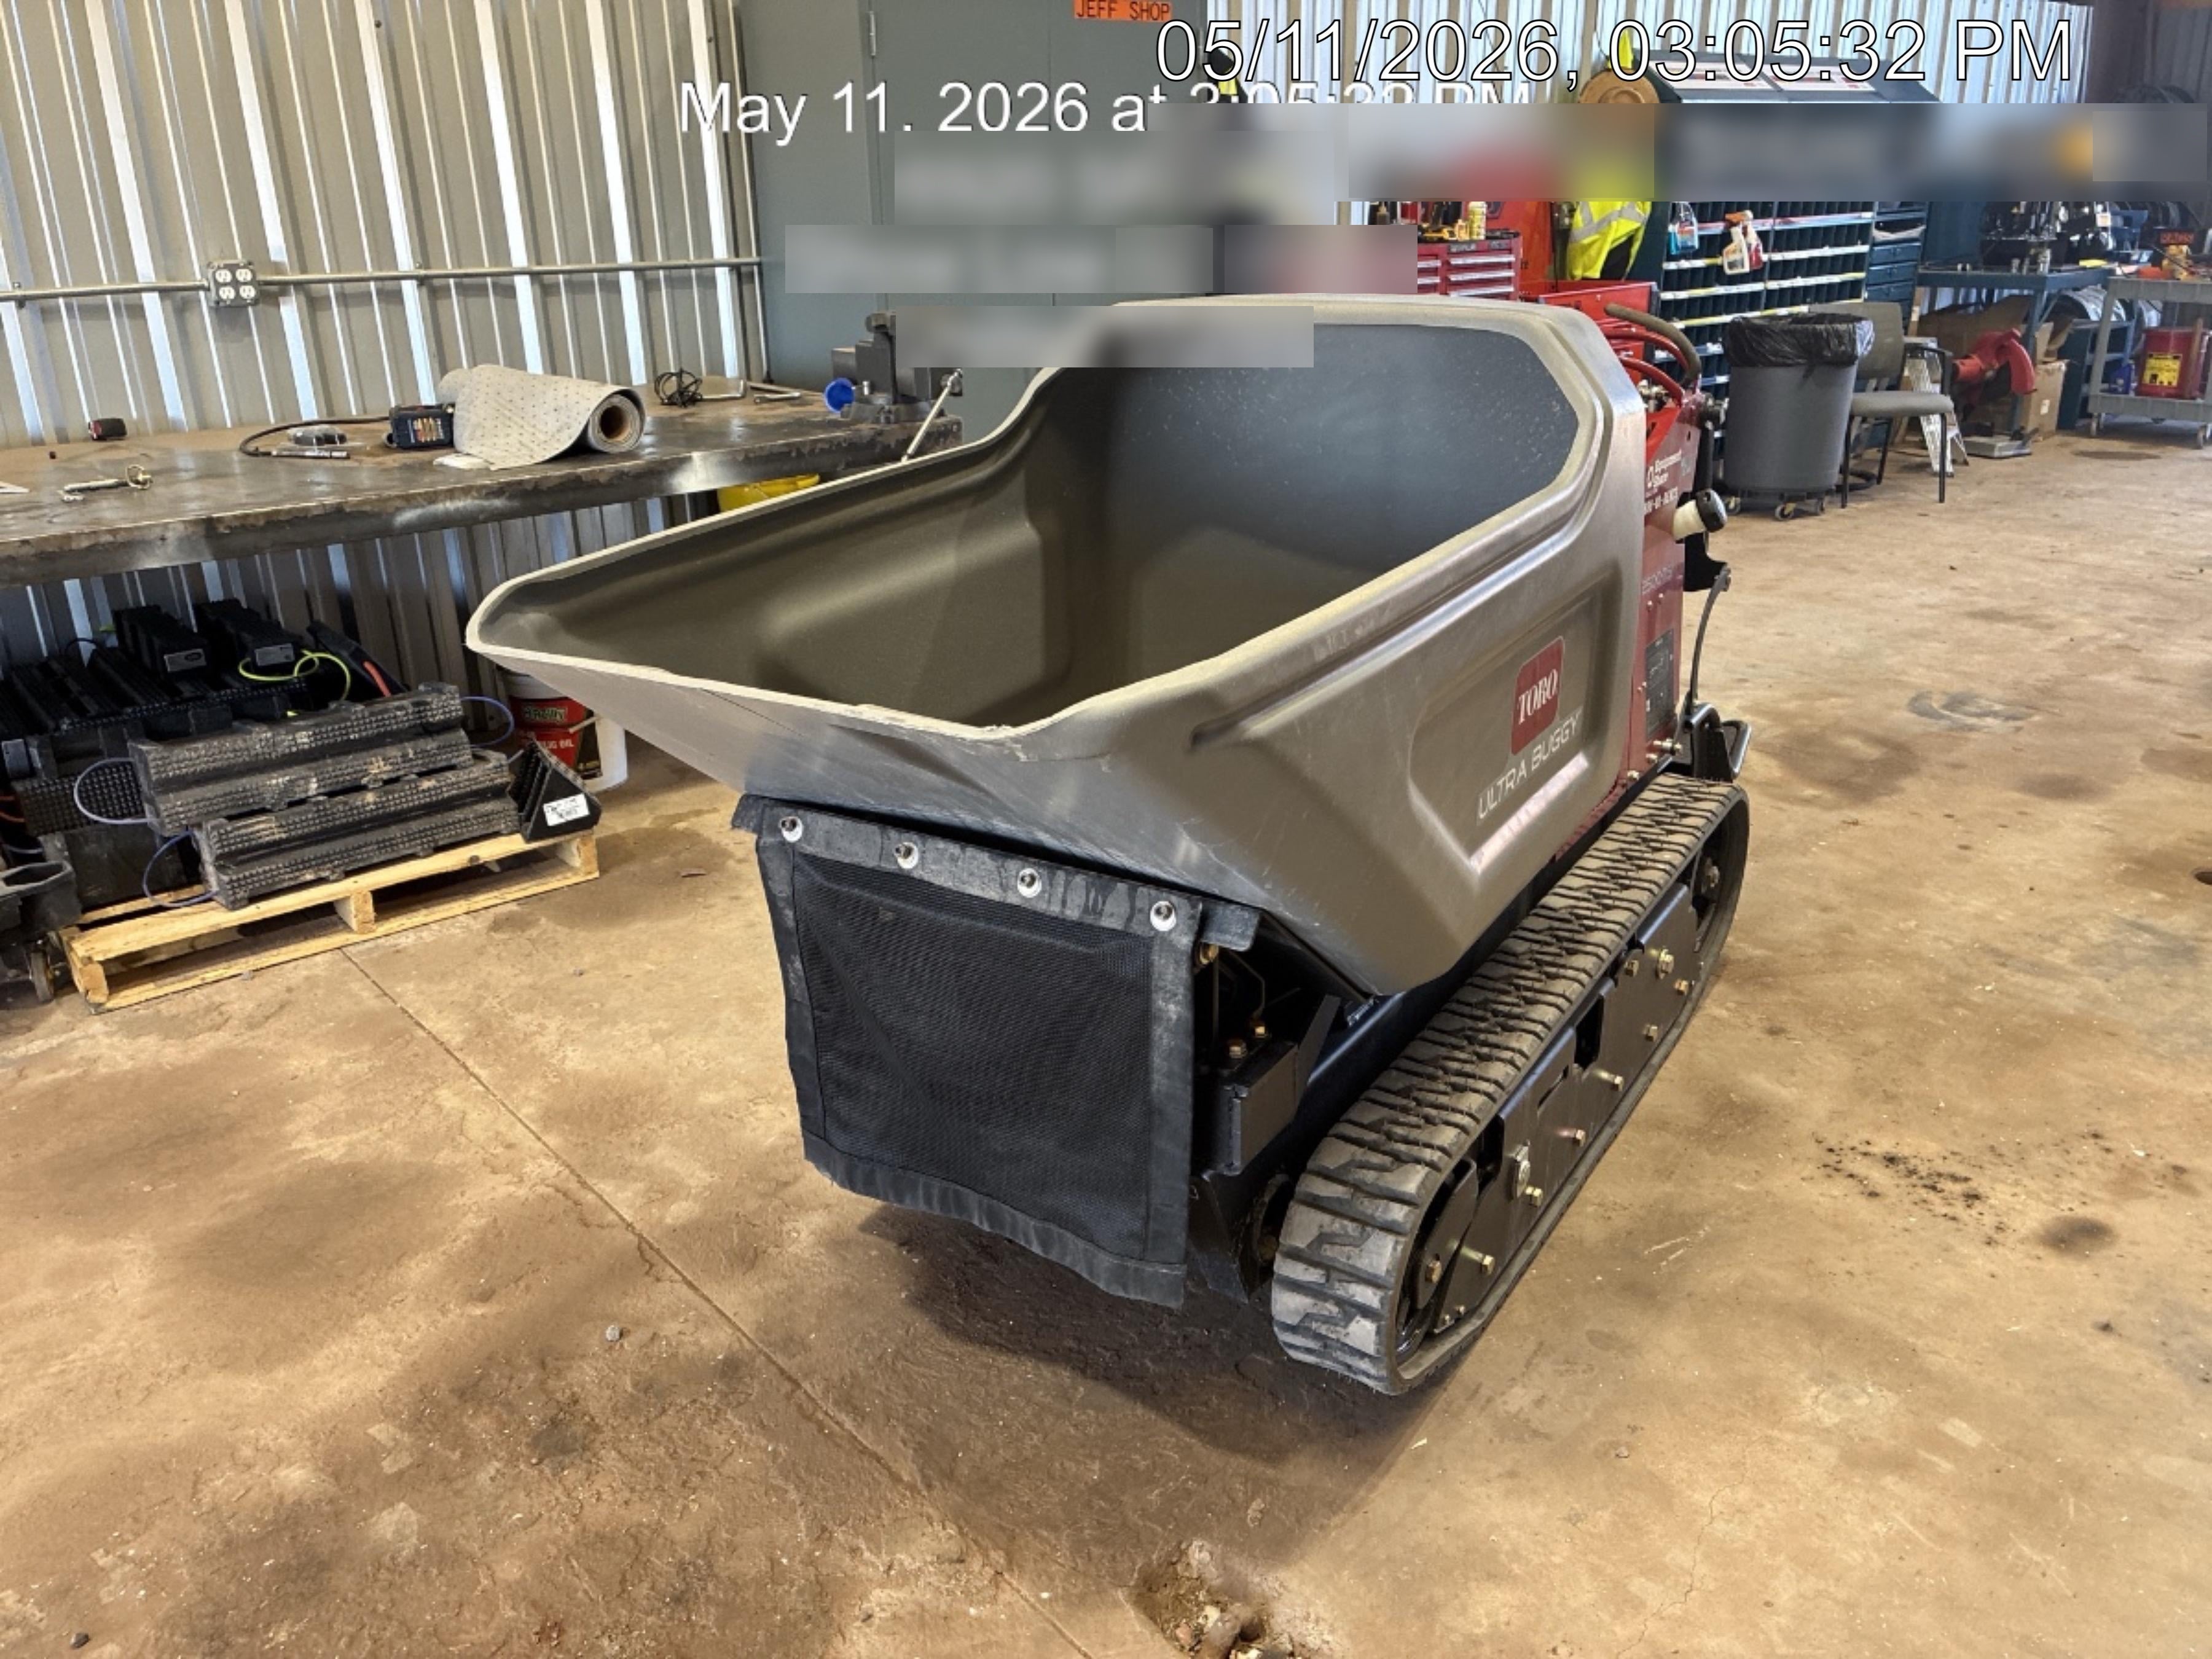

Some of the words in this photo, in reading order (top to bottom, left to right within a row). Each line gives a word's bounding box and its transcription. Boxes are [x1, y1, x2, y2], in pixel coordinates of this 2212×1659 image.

[1077, 0, 1118, 18] JEFF
[1129, 1, 1170, 21] SHOP
[1518, 669, 1559, 726] TORO
[1478, 759, 1528, 819] ULTRA
[1531, 706, 1583, 771] BUGGY
